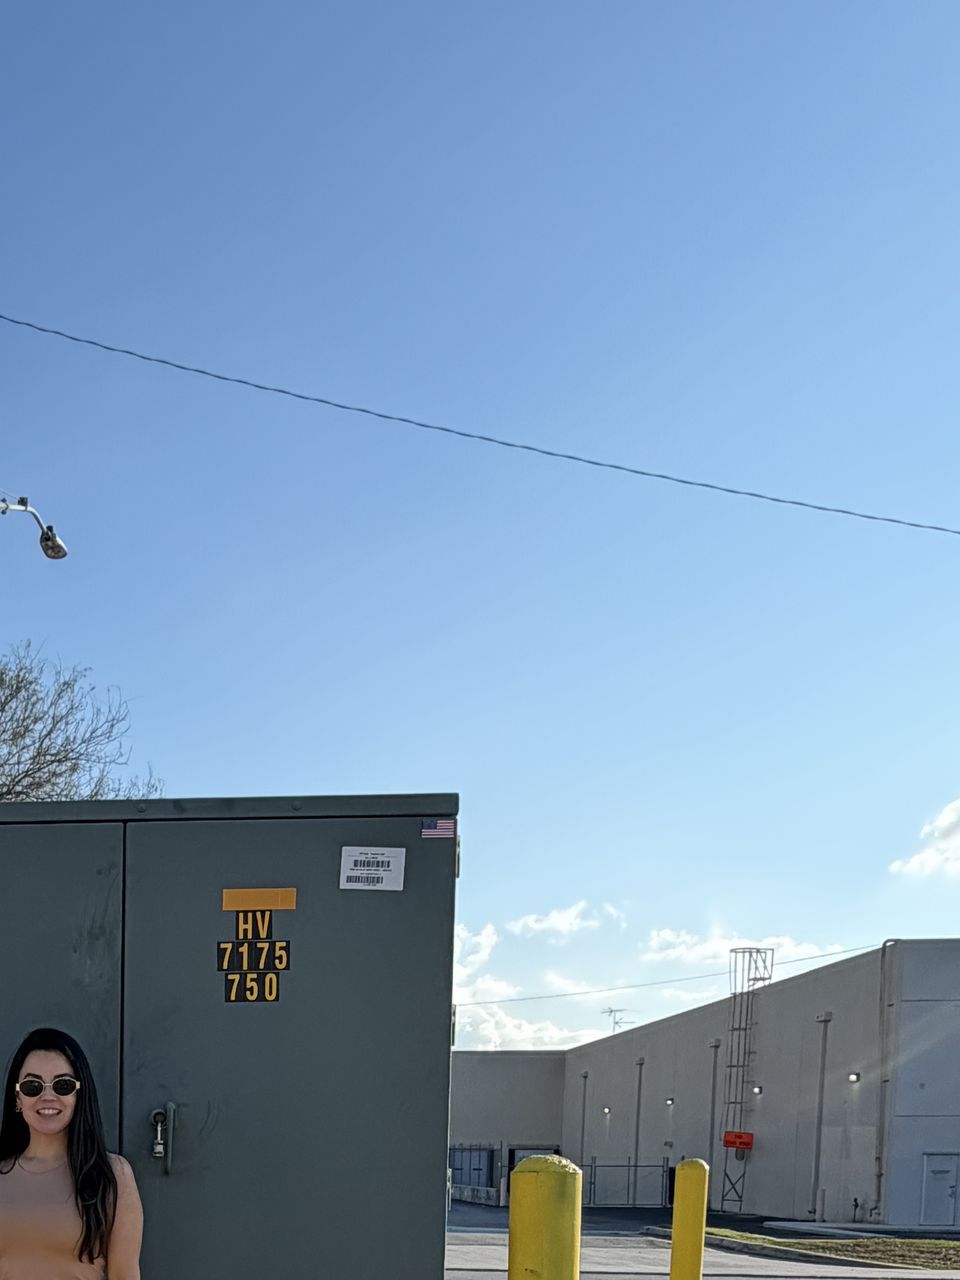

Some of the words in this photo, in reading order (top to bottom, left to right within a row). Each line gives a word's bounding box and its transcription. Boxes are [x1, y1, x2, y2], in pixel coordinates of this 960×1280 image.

[238, 911, 271, 940] HV
[220, 941, 288, 971] 7175
[227, 973, 278, 1001] 750
